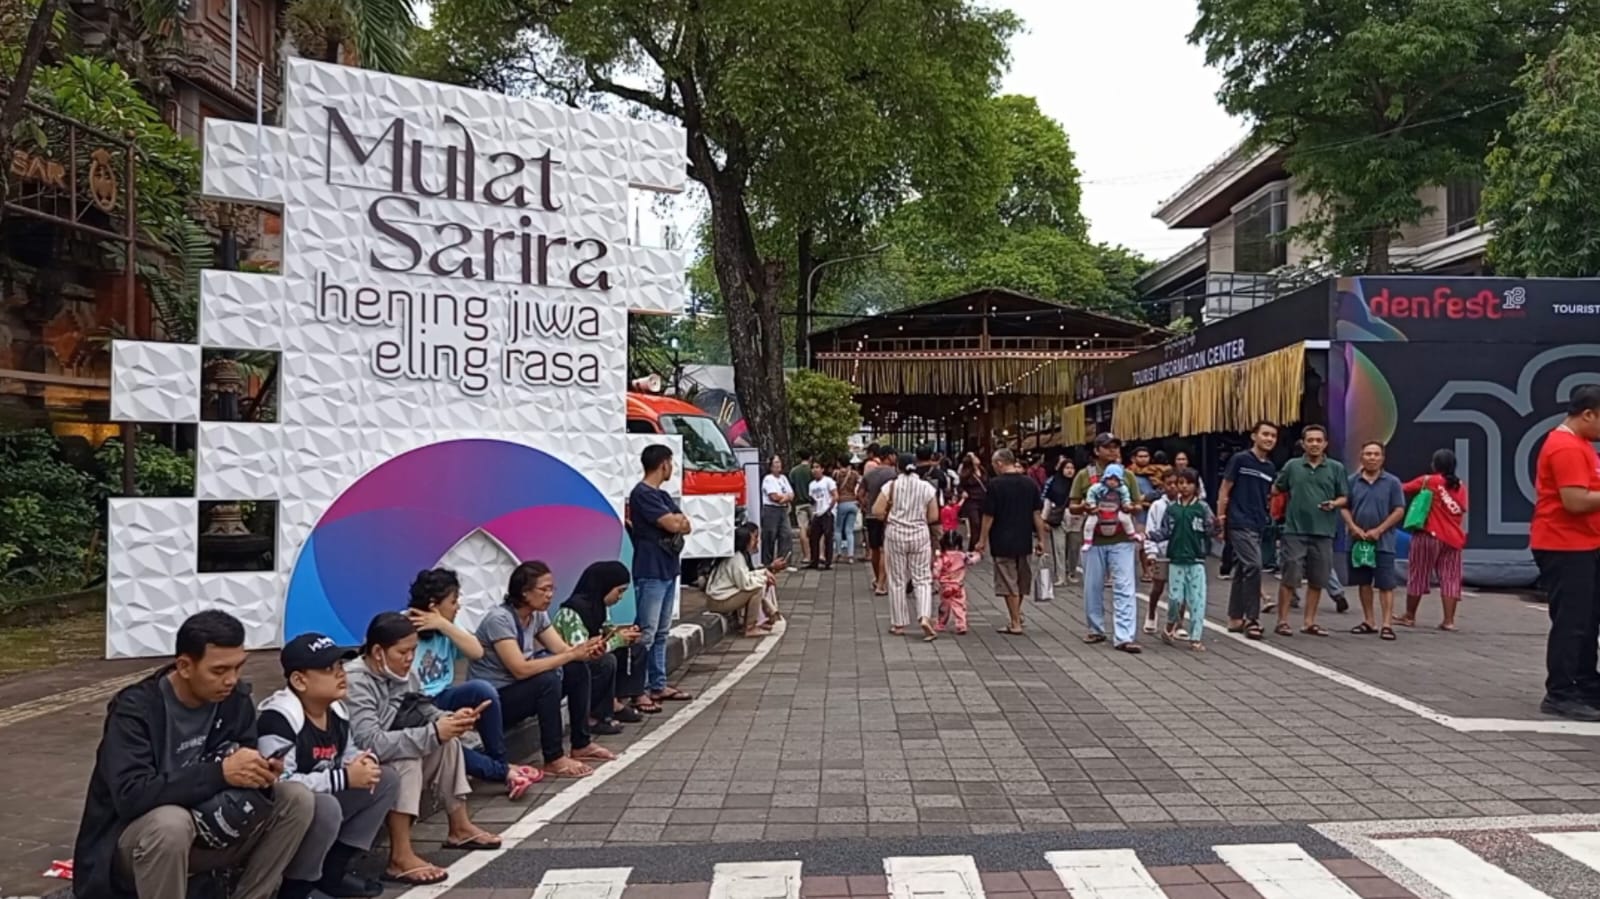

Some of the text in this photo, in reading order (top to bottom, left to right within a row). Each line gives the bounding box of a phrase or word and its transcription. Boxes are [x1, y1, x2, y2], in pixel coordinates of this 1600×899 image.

[322, 106, 563, 212] Mulat
[367, 195, 612, 290] Sarira
[320, 272, 600, 343] hening jiwa
[1370, 286, 1502, 319] denfest
[1552, 303, 1600, 314] TOURIST
[375, 329, 600, 391] eling rasa
[1131, 366, 1158, 386] TOURIST
[1158, 350, 1206, 379] INFORMATION
[1207, 338, 1245, 365] CENTER
